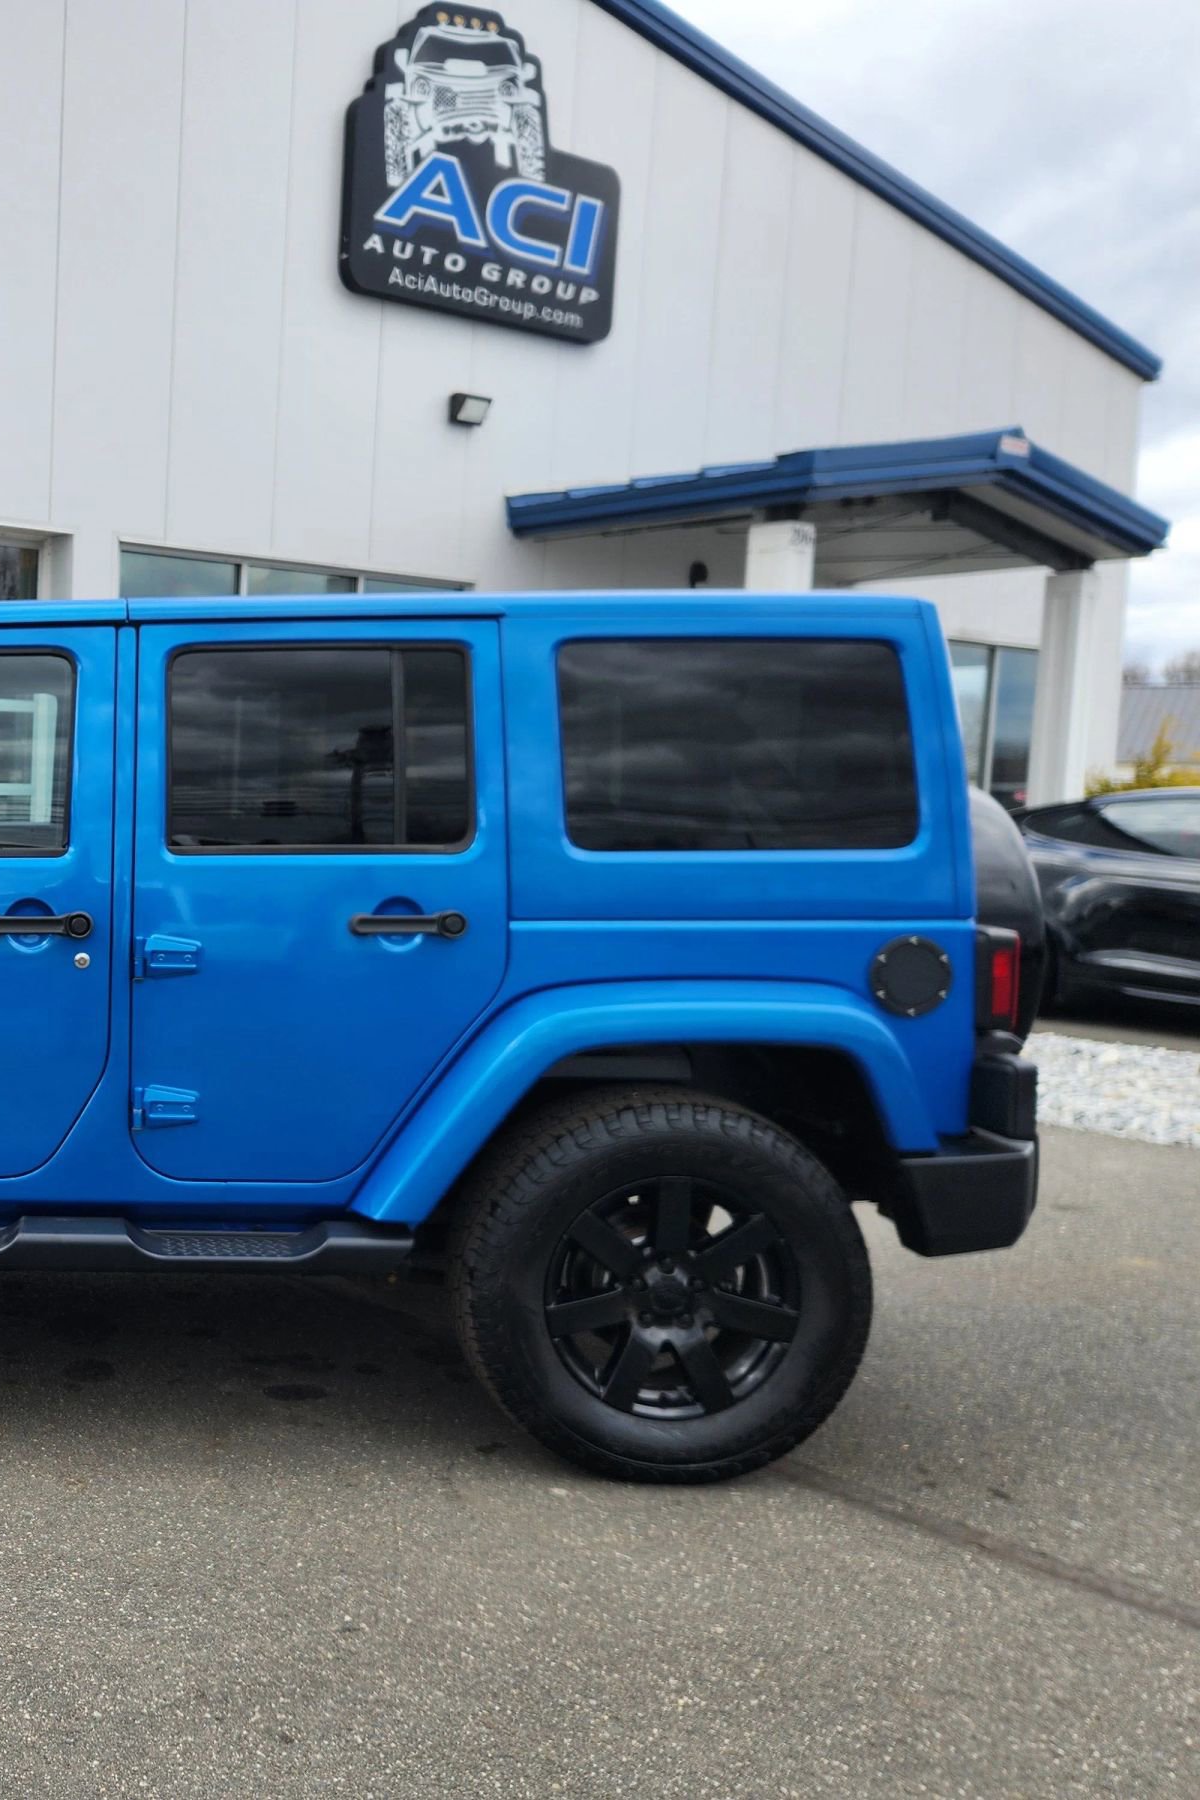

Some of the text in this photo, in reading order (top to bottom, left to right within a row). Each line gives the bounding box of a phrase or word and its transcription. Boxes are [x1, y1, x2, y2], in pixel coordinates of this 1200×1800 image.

[373, 150, 605, 275] ACI
[363, 233, 600, 305] AUTO GROUP
[388, 266, 584, 328] AciAutoGroup.com
